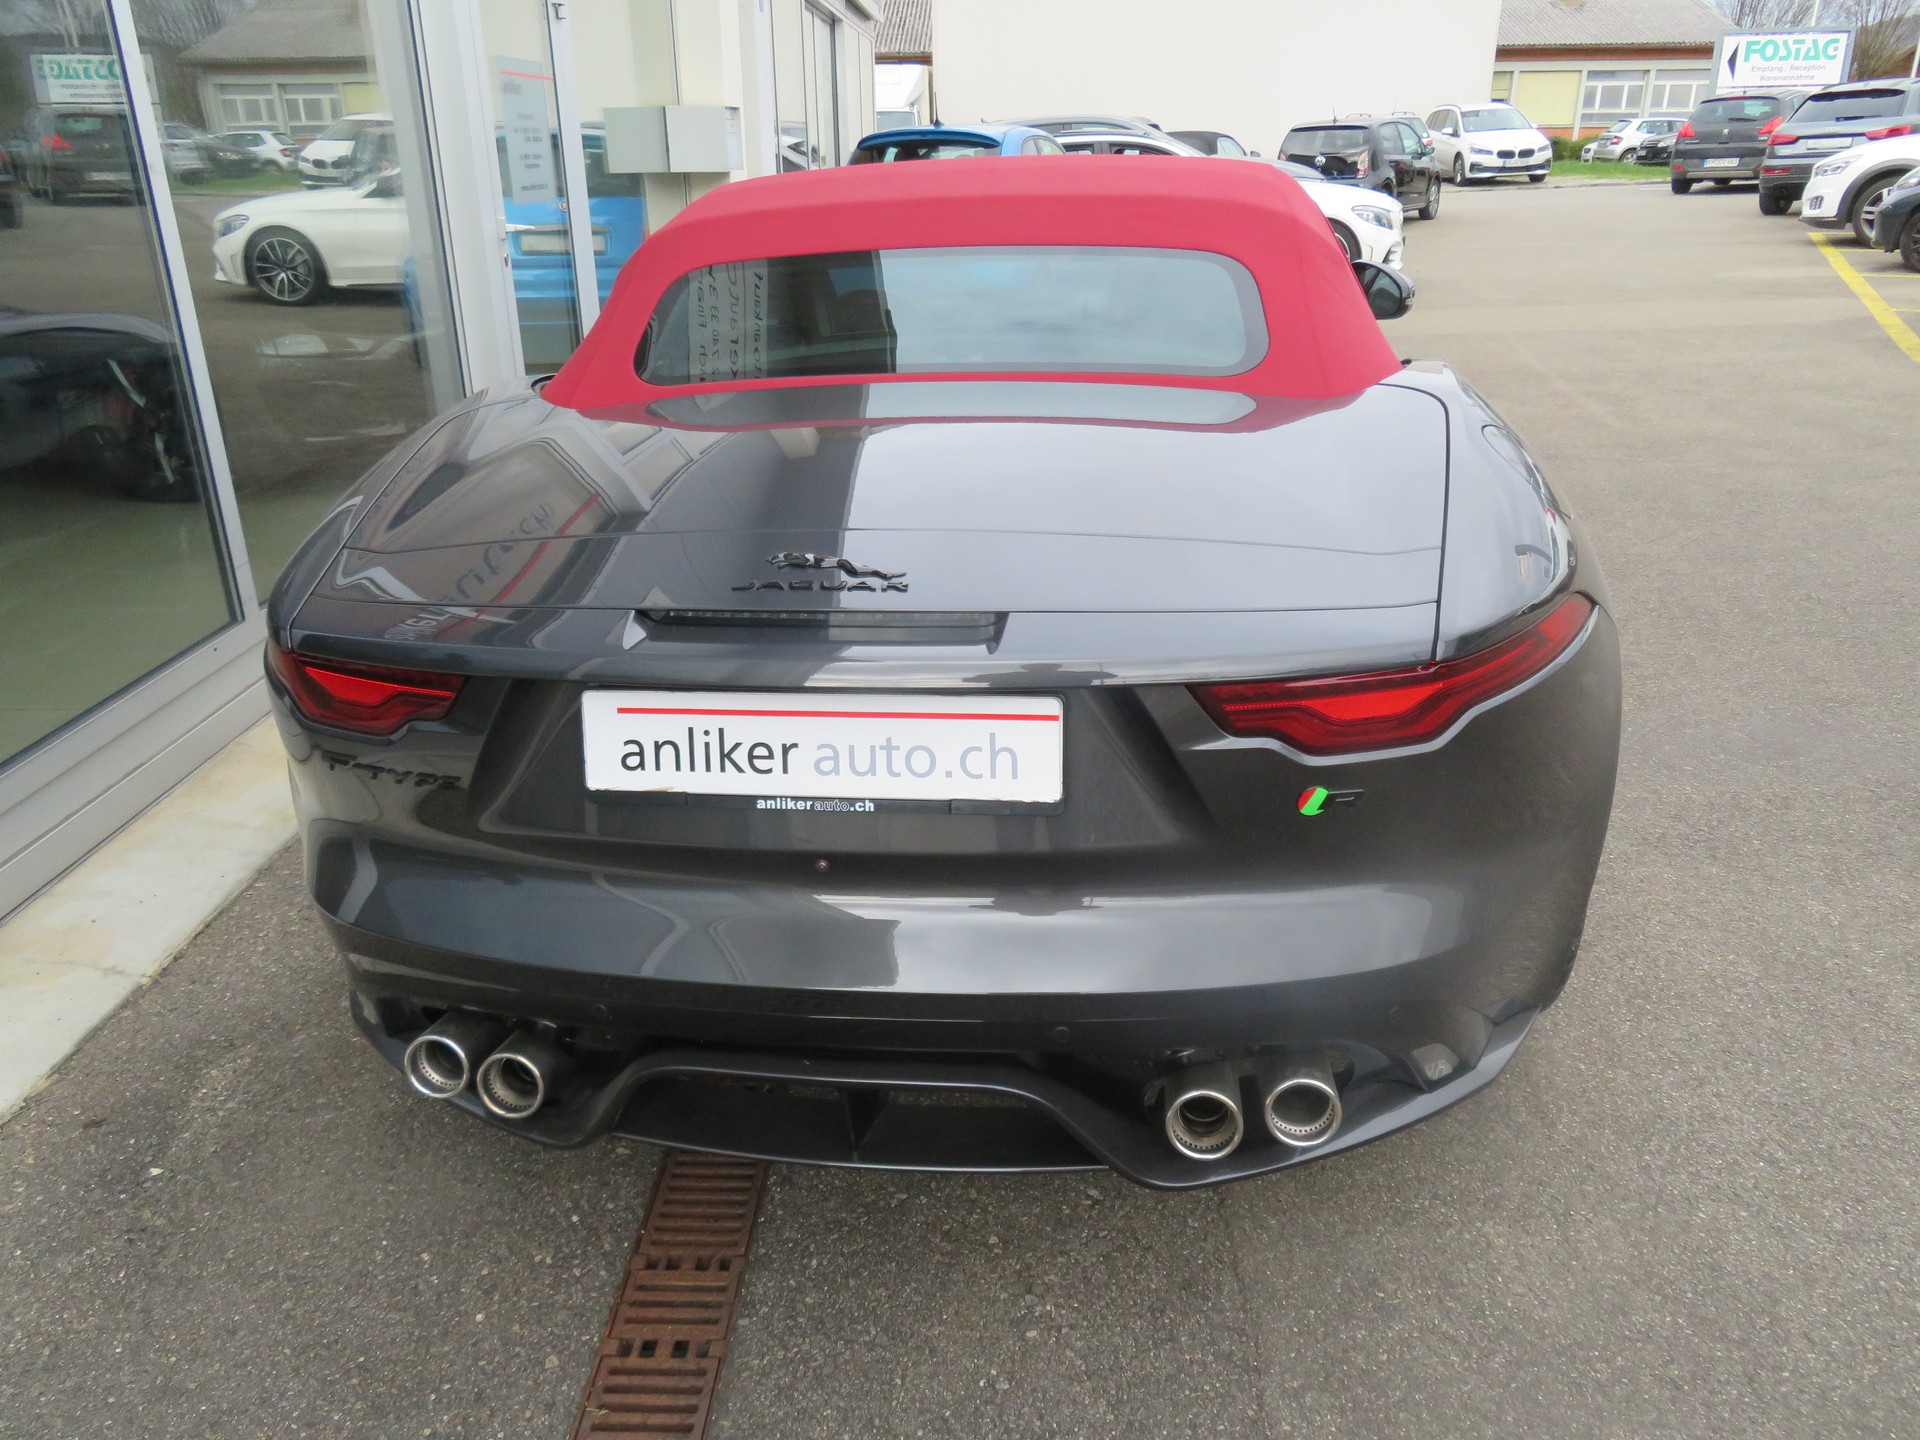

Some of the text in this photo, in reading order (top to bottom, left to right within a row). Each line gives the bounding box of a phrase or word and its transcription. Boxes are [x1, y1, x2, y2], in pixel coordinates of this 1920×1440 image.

[1743, 38, 1841, 62] FOSTAG
[1751, 64, 1784, 73] Empfang
[1789, 64, 1826, 73] Reception
[731, 579, 909, 593] JAGUAR
